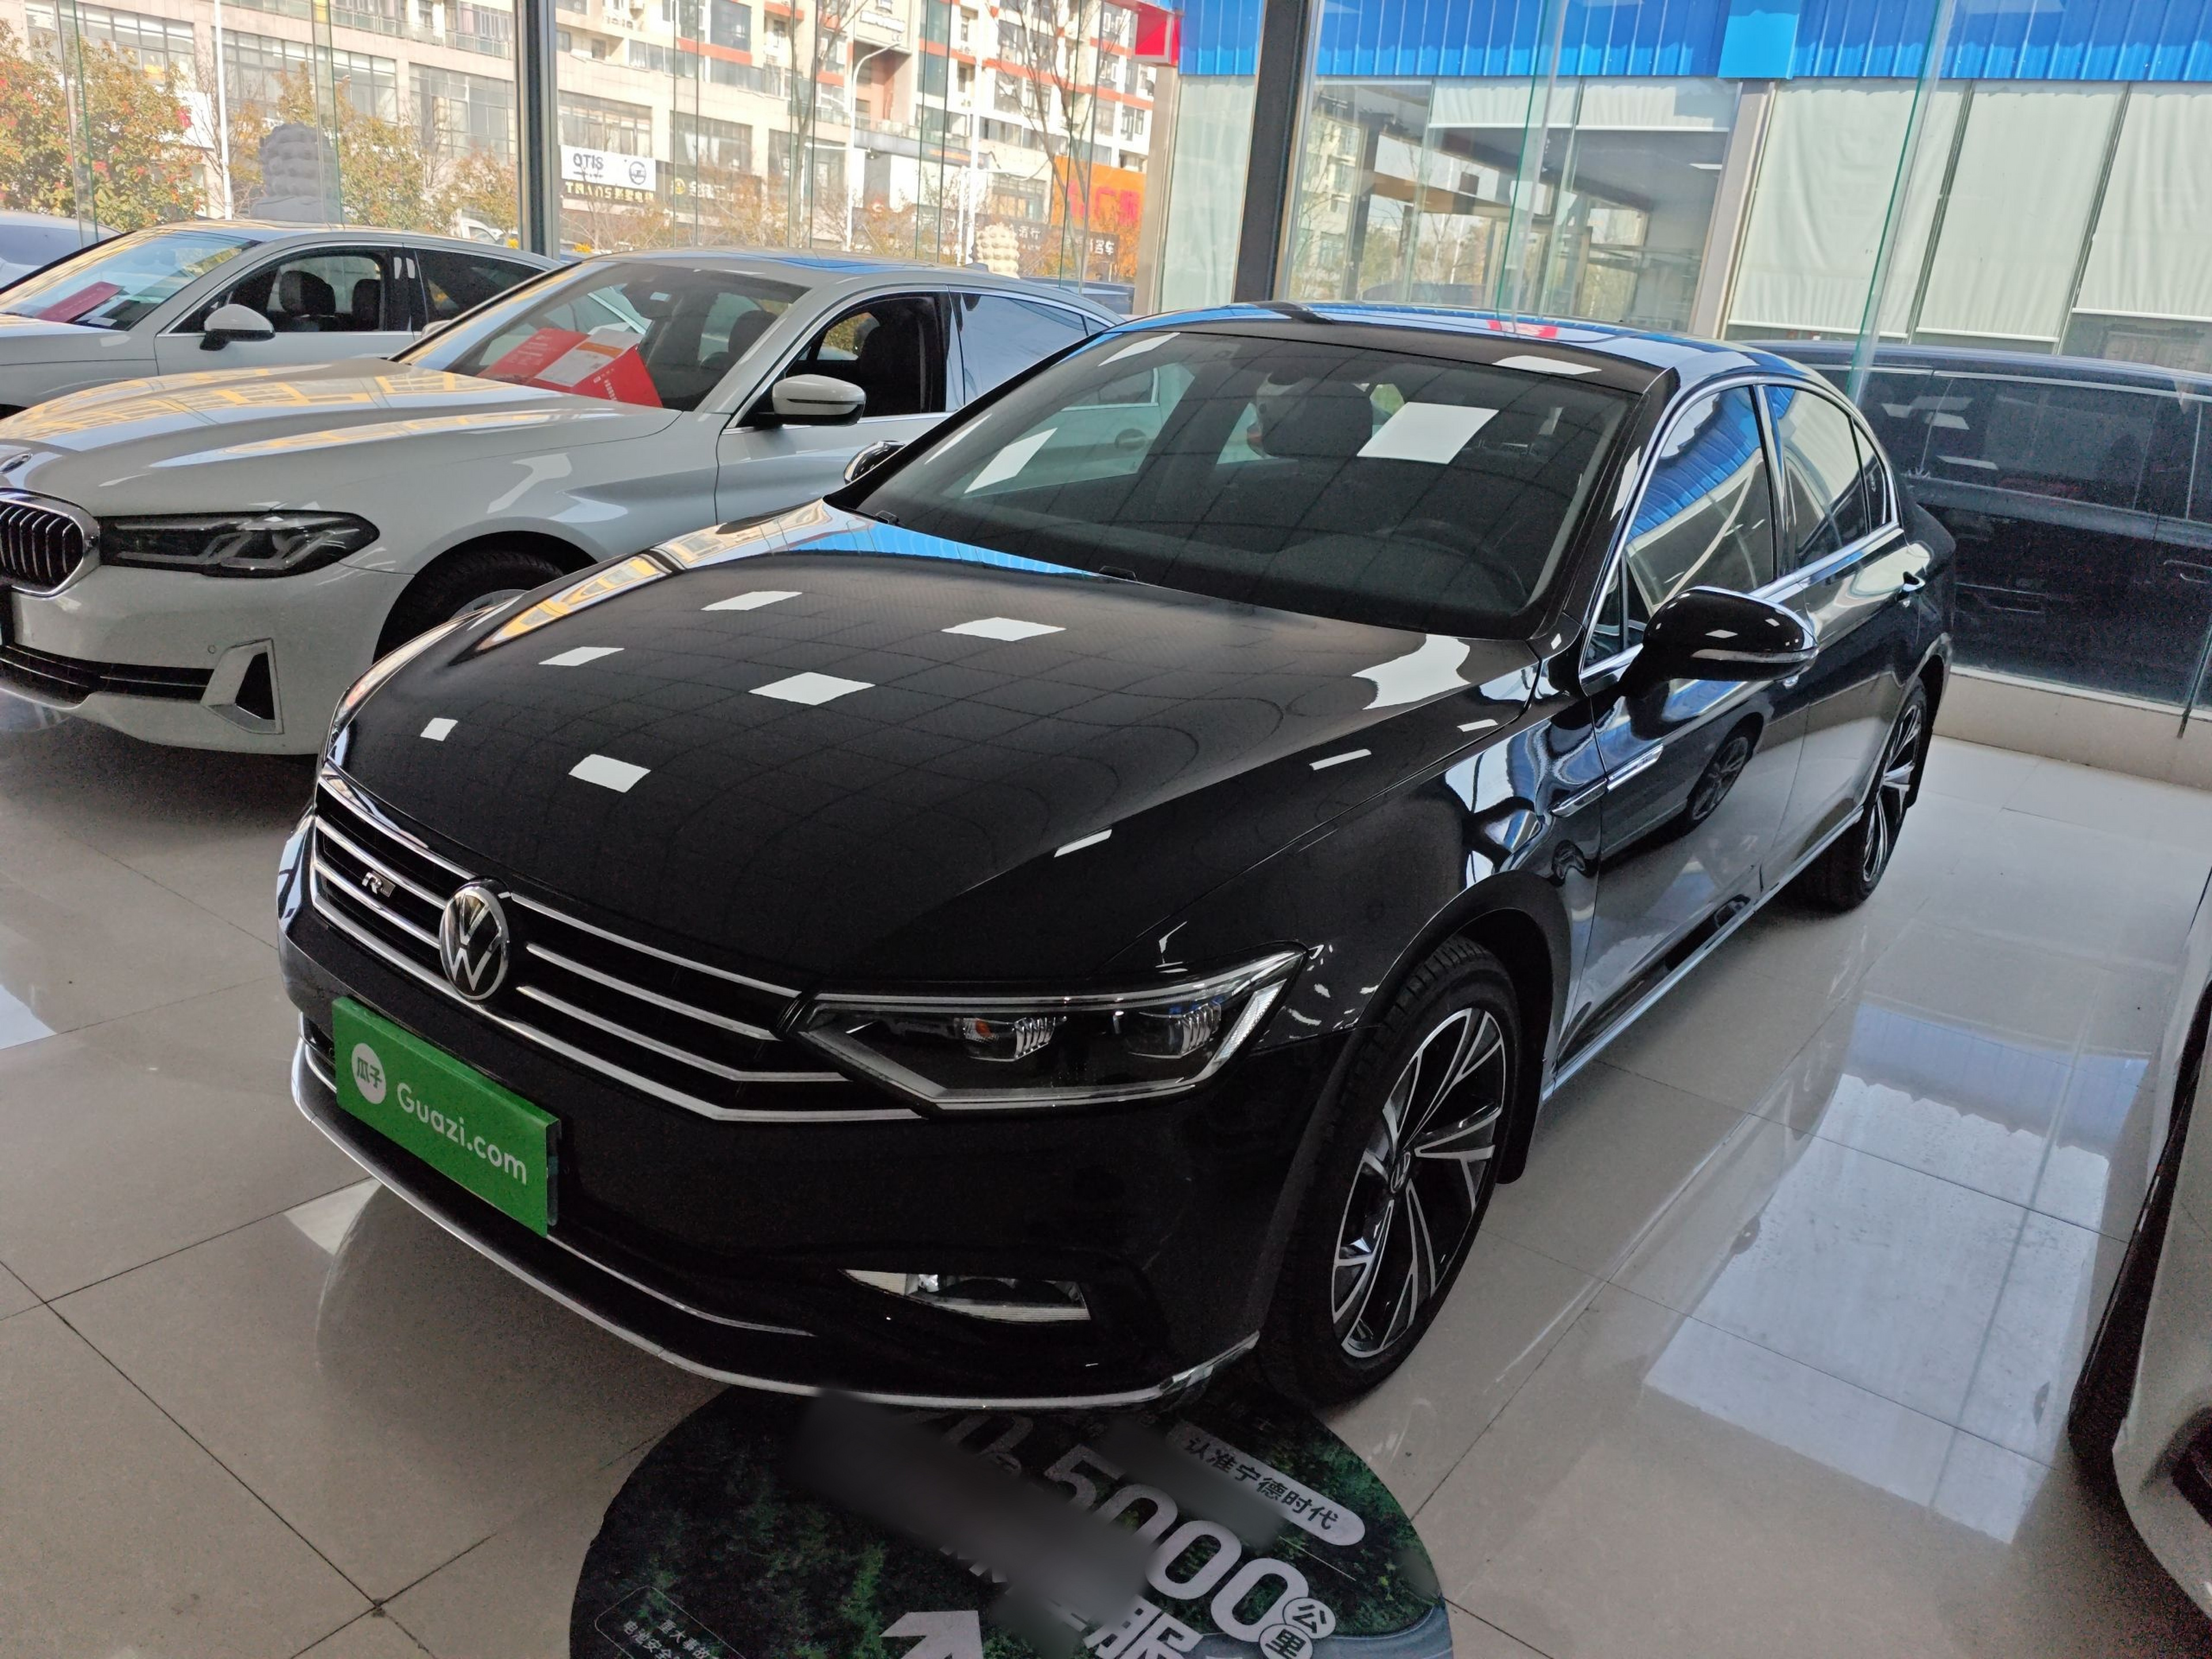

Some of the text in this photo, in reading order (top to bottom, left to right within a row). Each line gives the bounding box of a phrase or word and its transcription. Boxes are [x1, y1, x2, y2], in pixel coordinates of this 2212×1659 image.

[573, 153, 604, 170] OTIS
[355, 1056, 384, 1090] 瓜子
[397, 1082, 528, 1185] Guazi.com
[1184, 1437, 1339, 1531] 认准宁德时代
[657, 1618, 719, 1659] 重大事故
